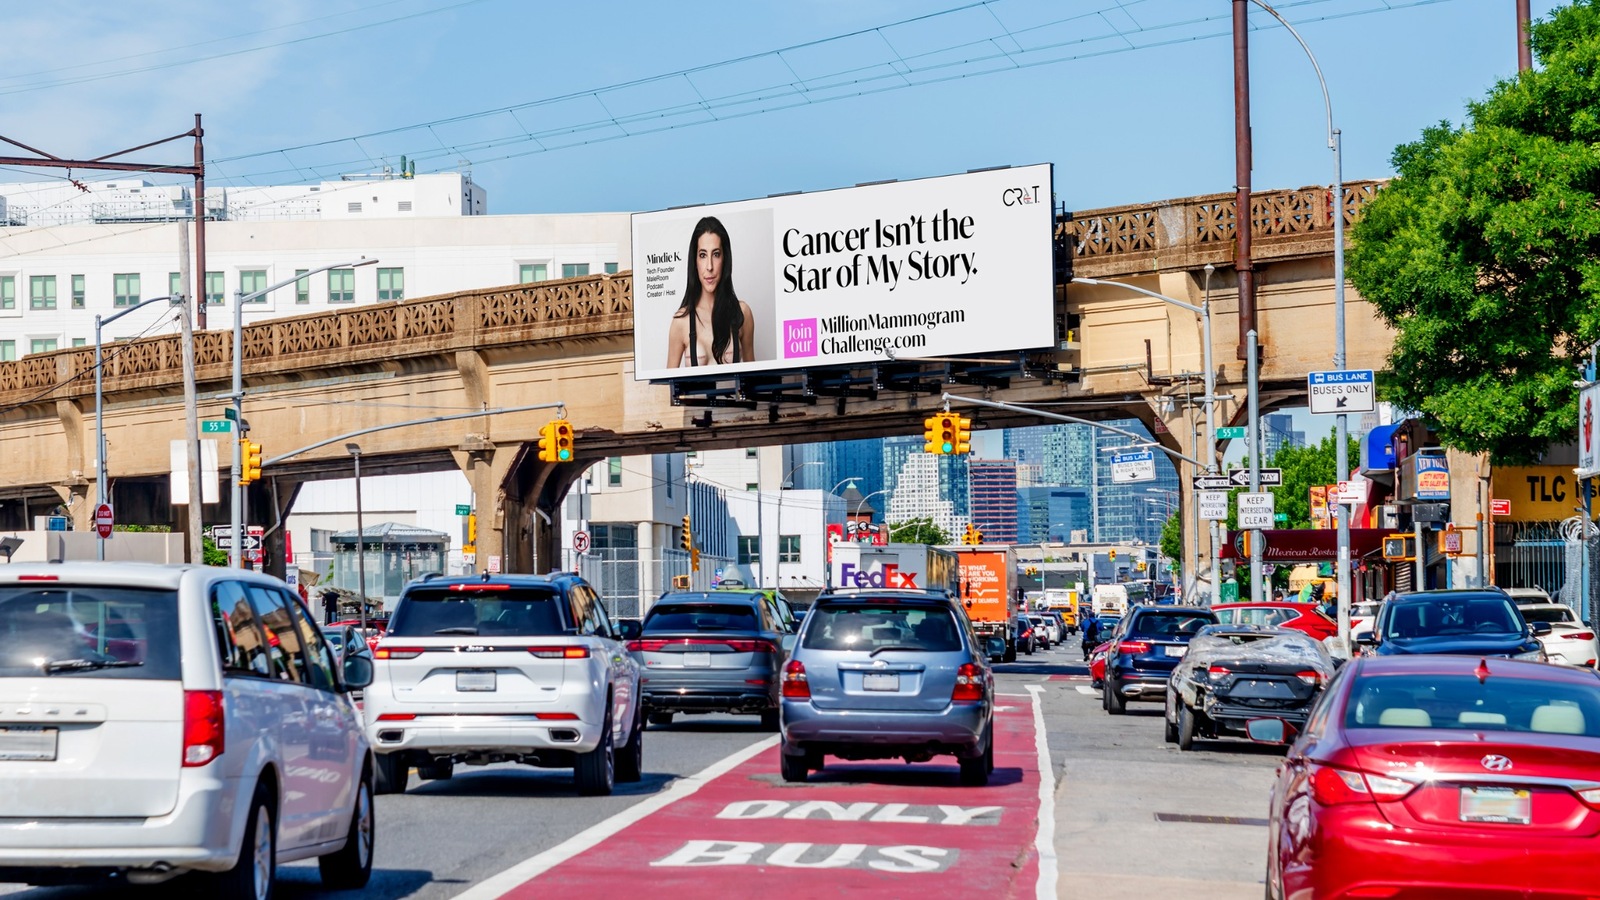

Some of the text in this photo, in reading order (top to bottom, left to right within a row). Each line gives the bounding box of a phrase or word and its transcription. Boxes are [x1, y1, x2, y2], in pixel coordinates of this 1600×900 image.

[783, 208, 975, 258] Cancer Isn't the
[646, 252, 673, 264] Mindie
[783, 250, 978, 294] Star of My Story.
[820, 309, 965, 335] MillionMammogram
[787, 324, 812, 343] Join
[790, 339, 812, 354] our
[821, 333, 926, 355] Challenge.com
[1327, 372, 1368, 382] BUS LANE
[1313, 384, 1369, 395] BUSES ONLY
[209, 421, 218, 432] 55
[1223, 428, 1231, 437] 55
[1418, 458, 1431, 471] NEW
[1526, 475, 1566, 502] TLC
[1246, 496, 1265, 504] KEEP
[1244, 517, 1268, 525] CLEAR
[1267, 546, 1307, 557] Mexican
[841, 563, 918, 589] FedEx
[715, 800, 1003, 826] ONLY
[649, 840, 949, 873] BUS
